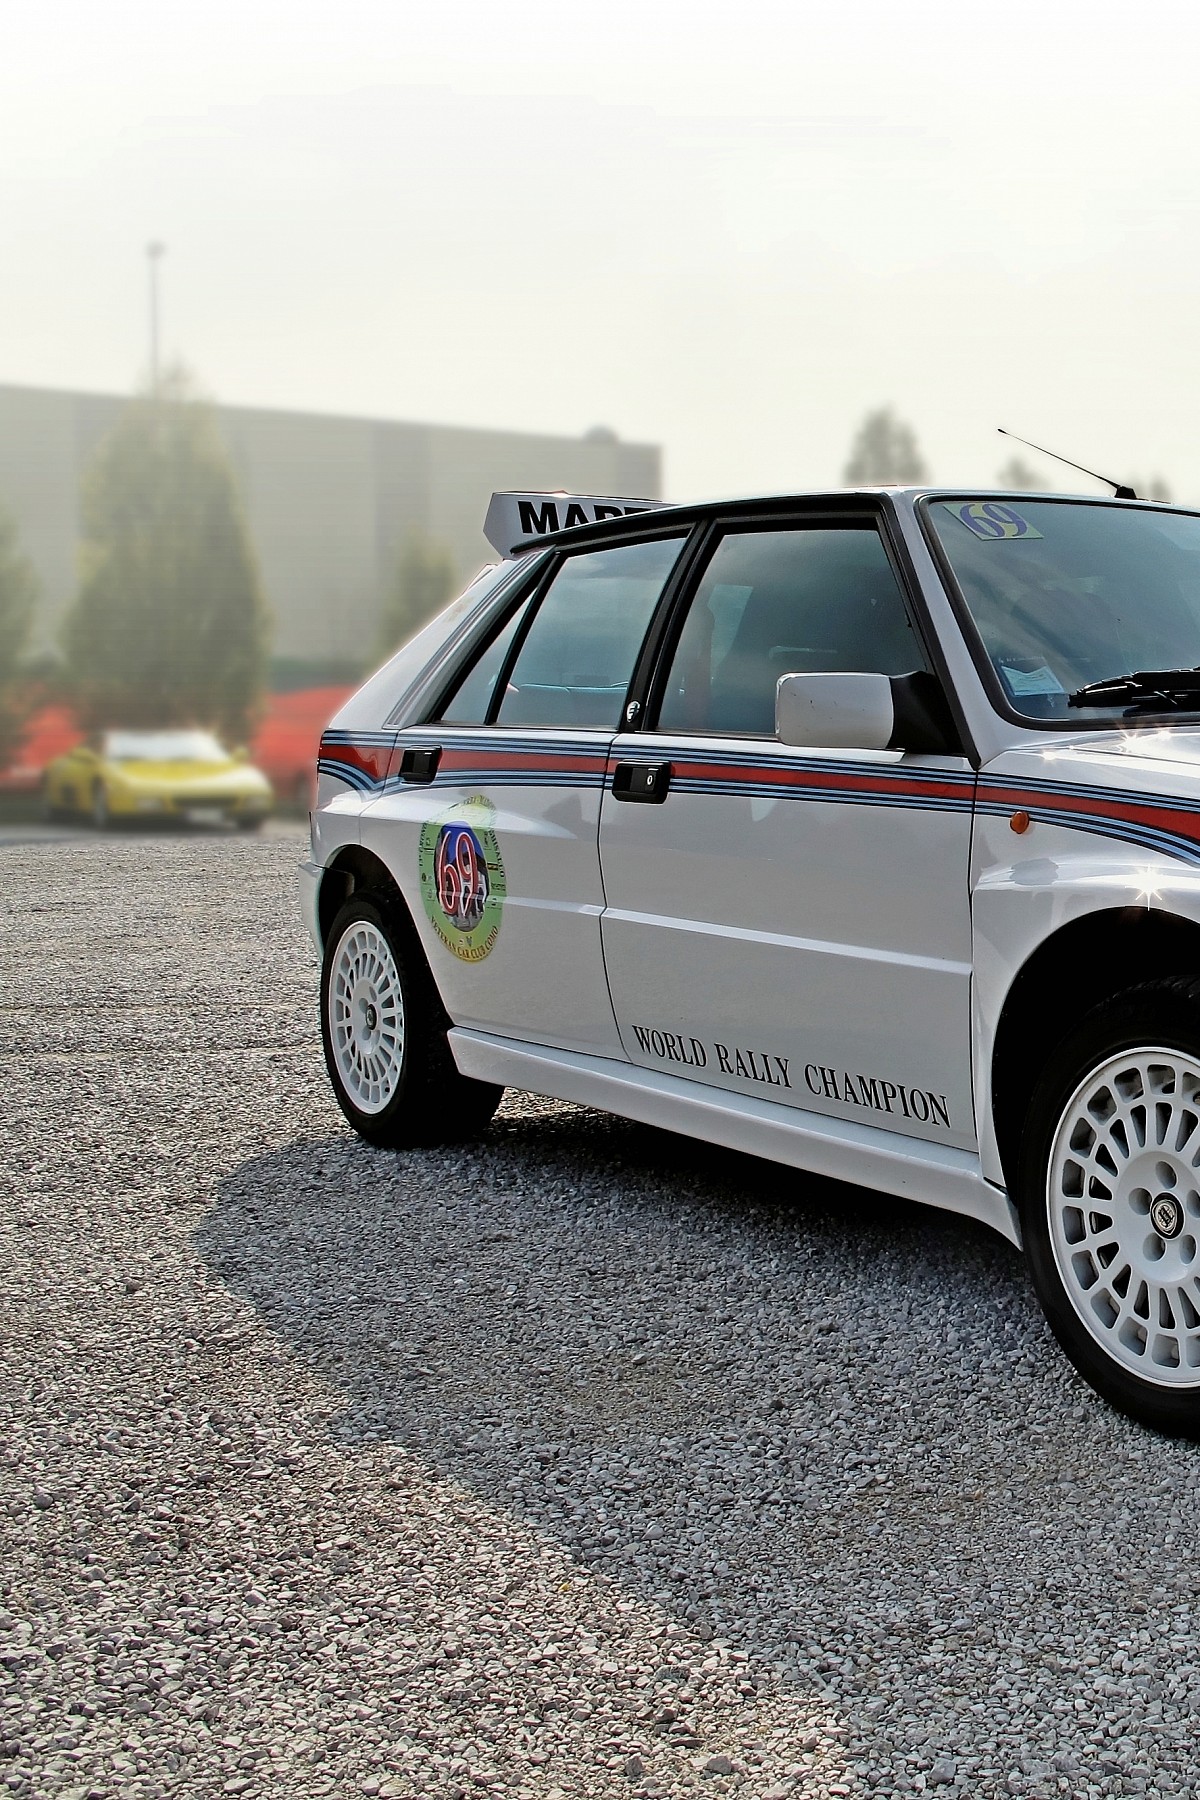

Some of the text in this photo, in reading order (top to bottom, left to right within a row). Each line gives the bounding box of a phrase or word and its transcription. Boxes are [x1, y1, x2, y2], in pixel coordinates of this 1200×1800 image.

[959, 503, 1028, 537] 69
[438, 830, 479, 917] 69
[457, 946, 470, 959] CAR
[471, 945, 486, 959] CLUB
[484, 925, 499, 951] COMO
[632, 1025, 951, 1129] WORLD RALLY CHAMPION
